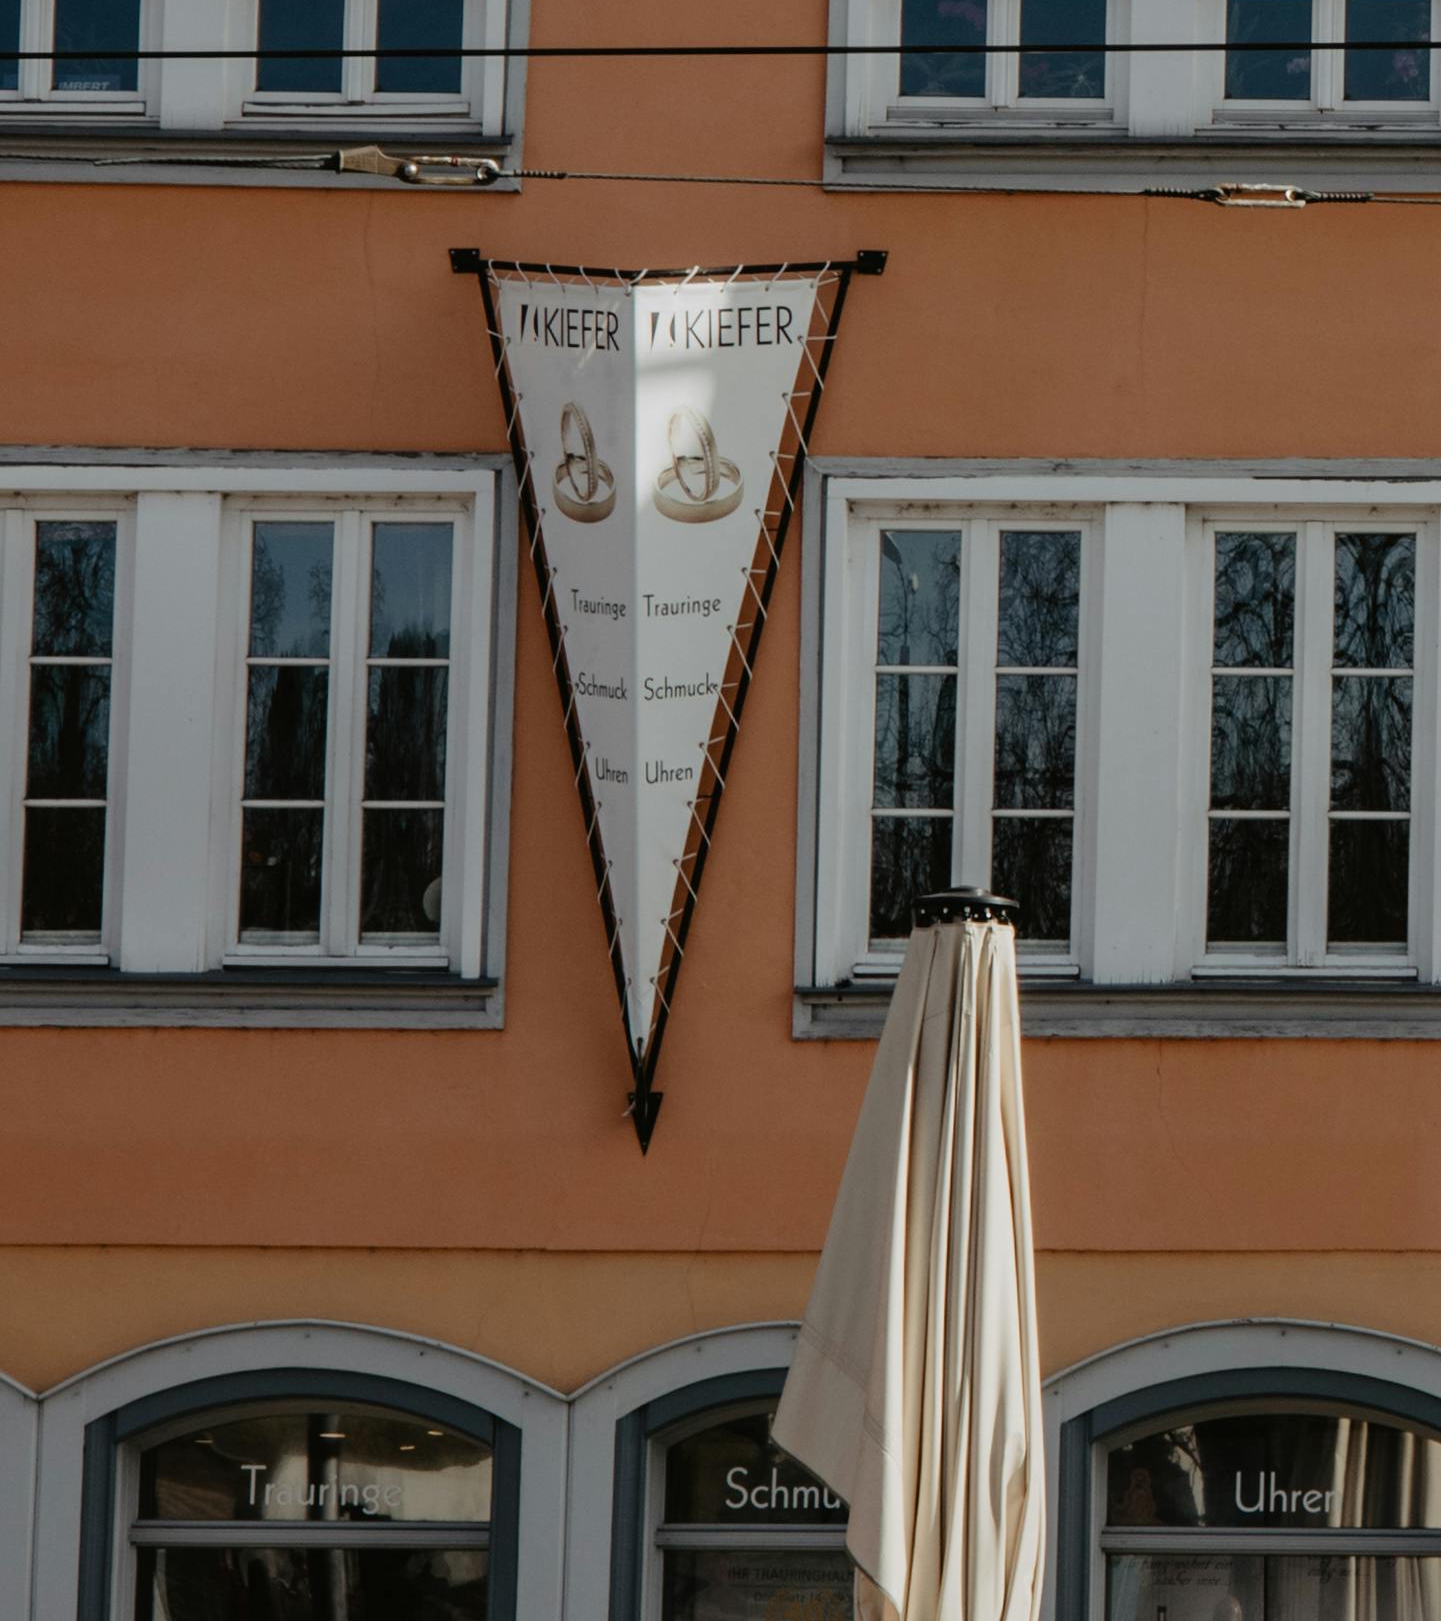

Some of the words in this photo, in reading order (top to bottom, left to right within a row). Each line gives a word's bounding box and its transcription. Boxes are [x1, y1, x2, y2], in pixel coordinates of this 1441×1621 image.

[544, 307, 619, 350] KIEFER
[686, 306, 793, 348] KIEFER
[571, 589, 626, 620] Trauringe
[643, 594, 721, 617] Trauringe
[578, 672, 628, 700] Schmuck
[644, 673, 714, 701] Schmuck
[595, 758, 628, 784] Uhren
[645, 761, 693, 783] Uhren
[240, 1465, 403, 1514] Trauringe
[725, 1466, 840, 1509] Schmu
[754, 1567, 853, 1583] TRAURINGHAU
